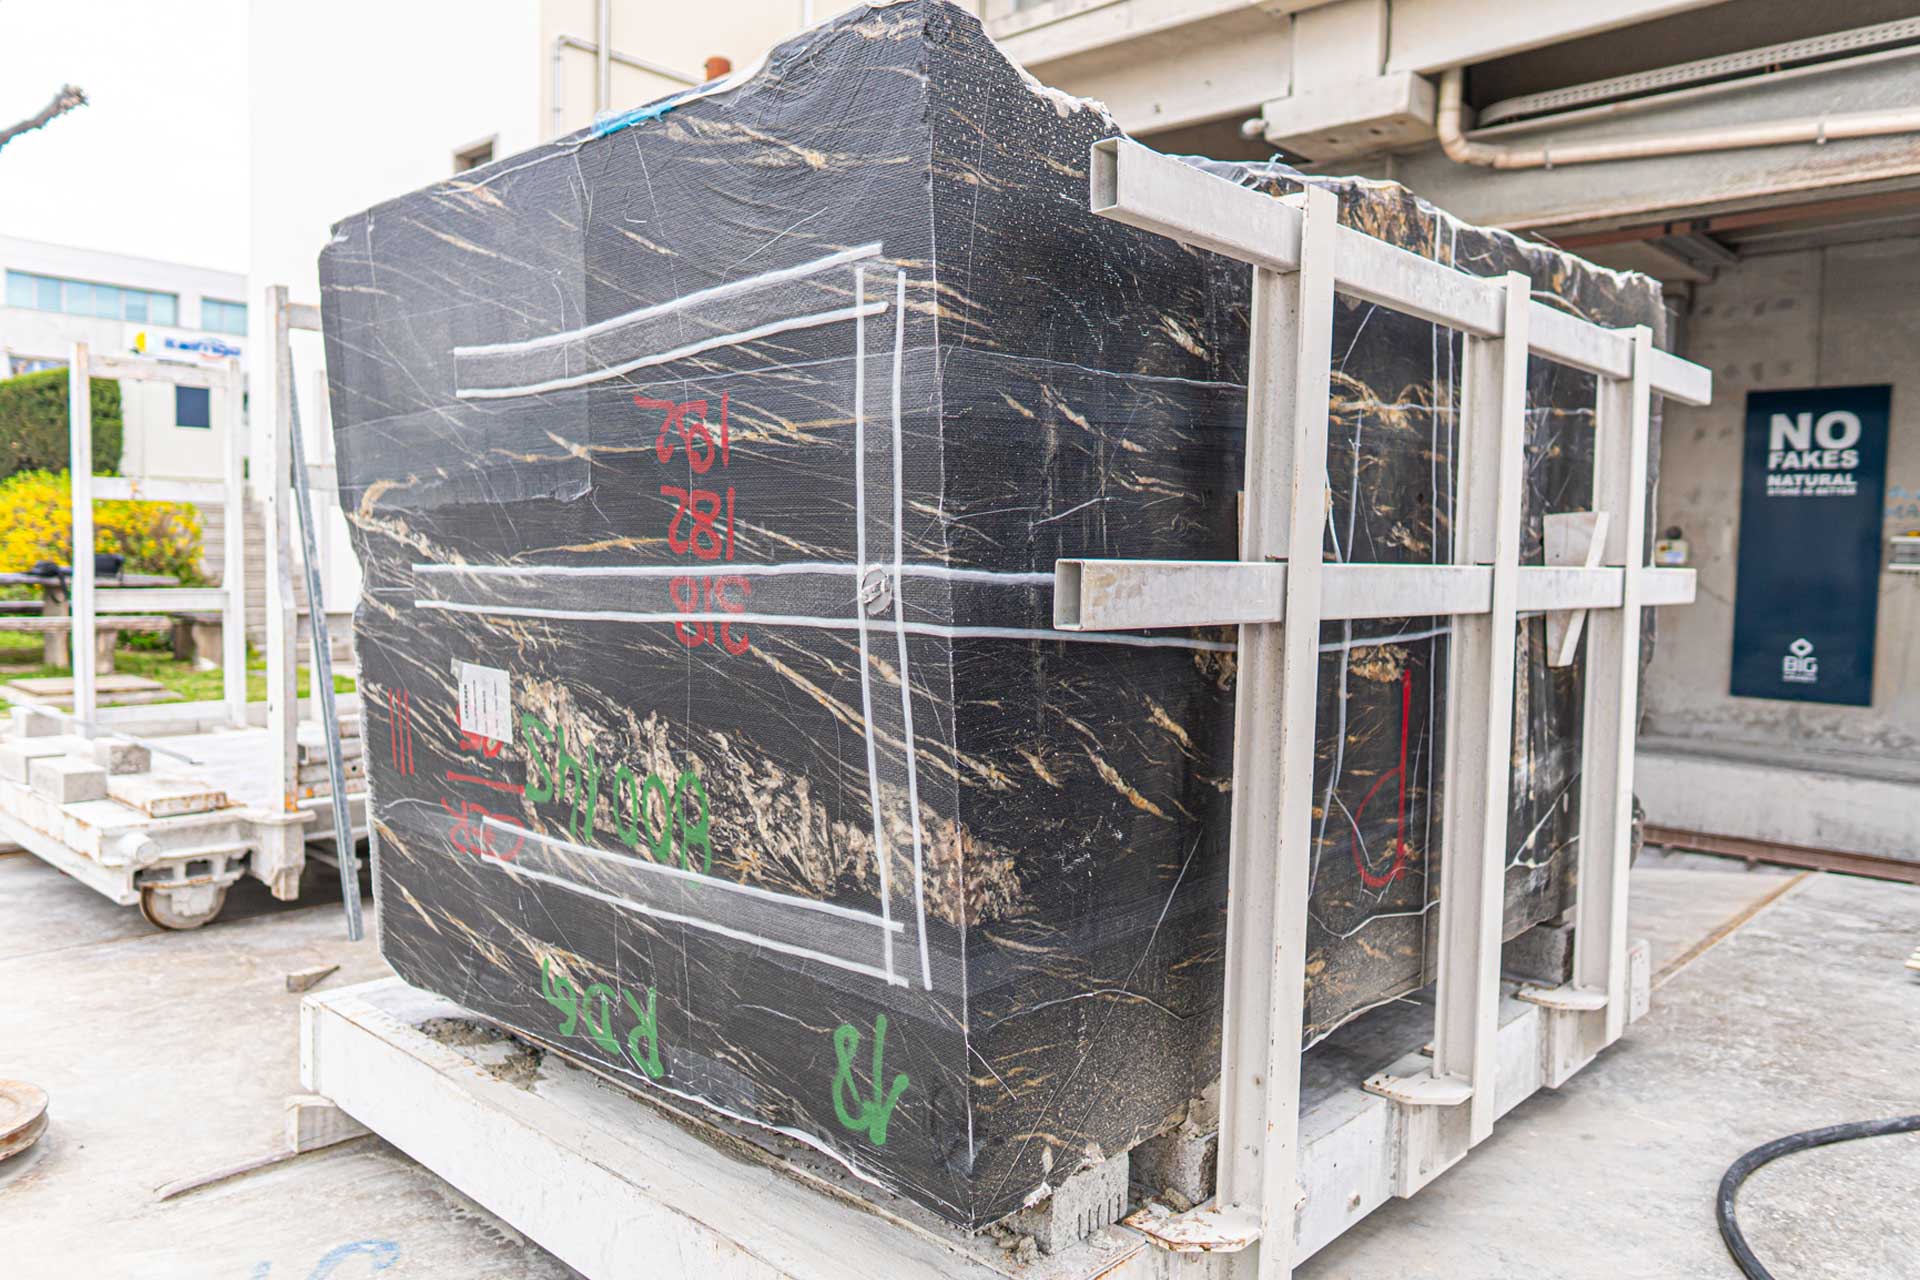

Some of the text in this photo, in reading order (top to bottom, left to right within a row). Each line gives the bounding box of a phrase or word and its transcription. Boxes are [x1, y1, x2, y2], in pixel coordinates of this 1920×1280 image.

[1769, 410, 1861, 451] NO
[1768, 449, 1859, 470] FAKES
[1767, 474, 1857, 487] NATURAL
[1783, 656, 1818, 673] BIG
